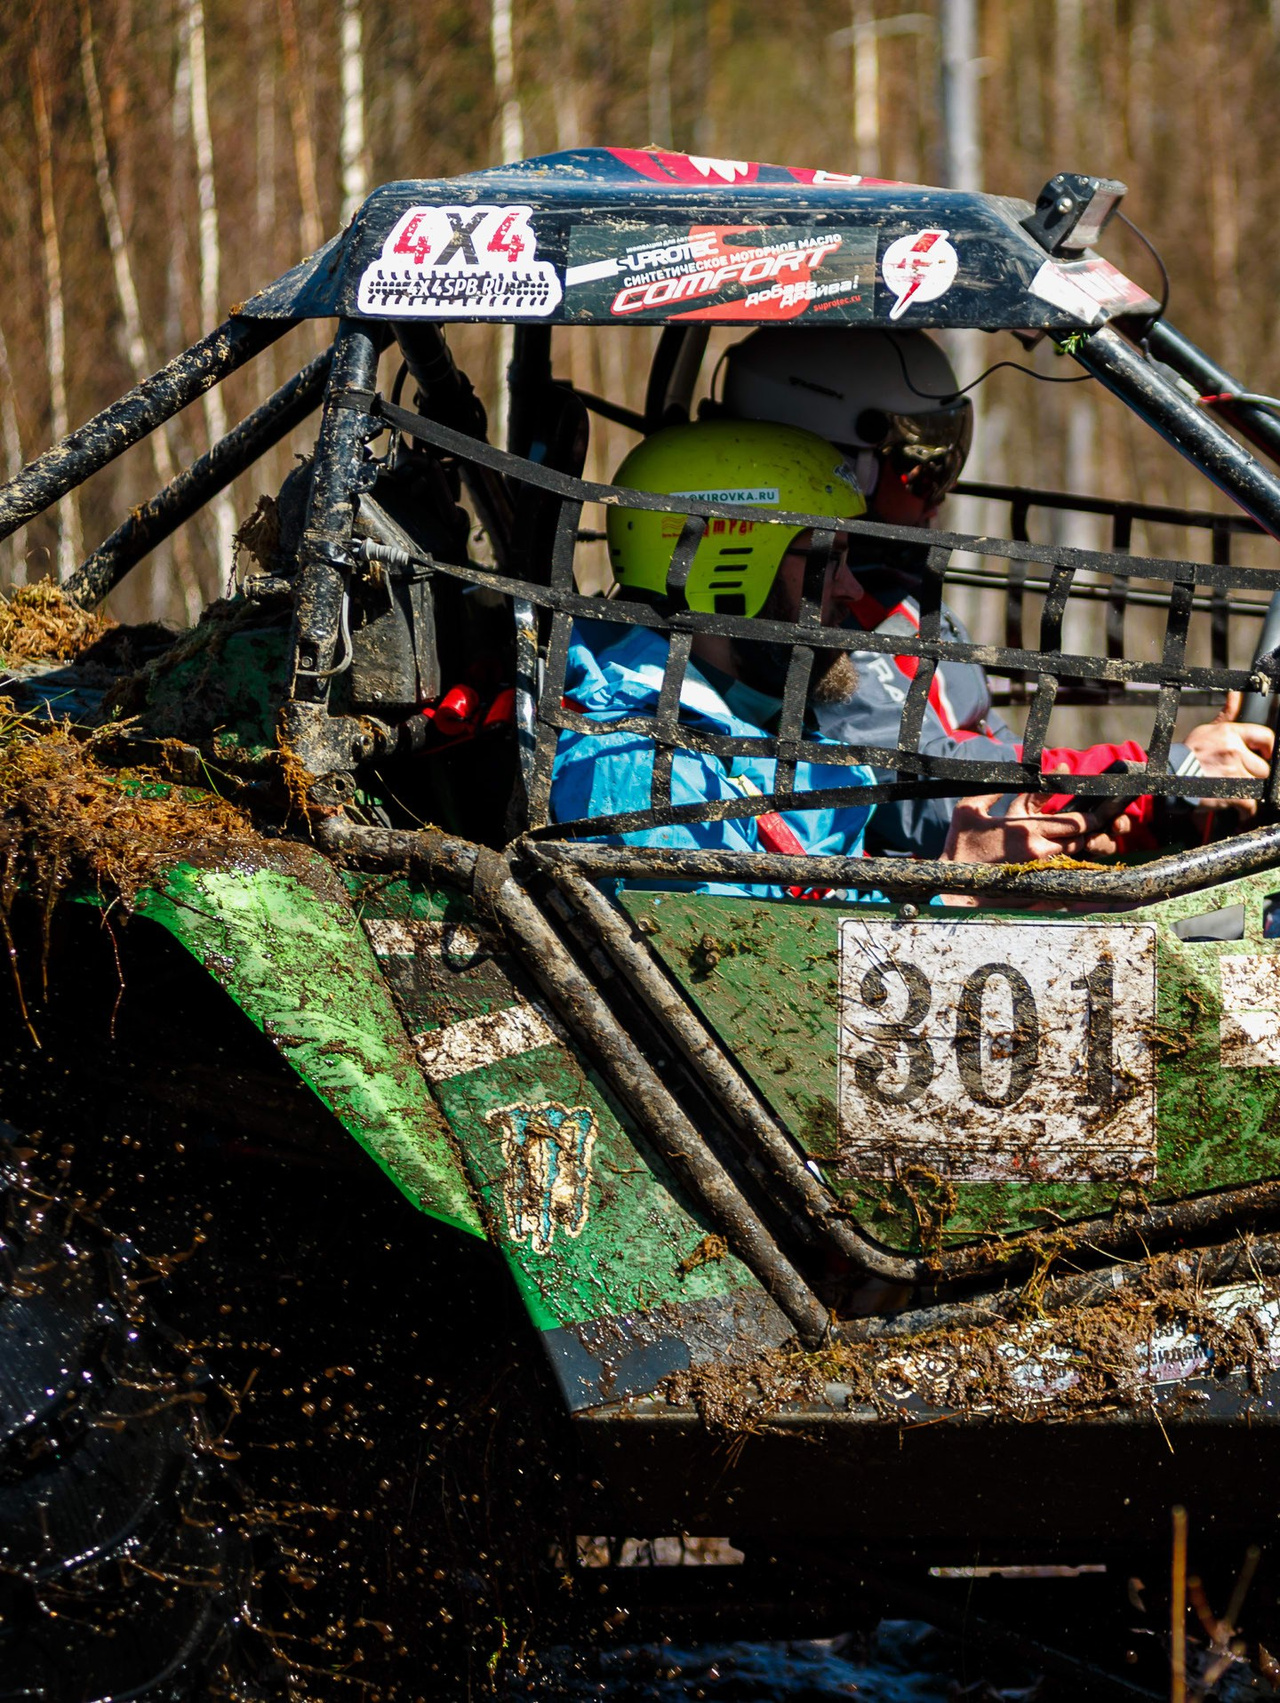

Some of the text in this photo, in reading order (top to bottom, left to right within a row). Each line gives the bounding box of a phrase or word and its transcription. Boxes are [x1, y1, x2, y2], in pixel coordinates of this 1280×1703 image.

[393, 212, 525, 266] 4X4
[623, 233, 843, 288] СИНТЕТИЧЕСКОЕ МОТОРНОЕ МАСЛО
[612, 242, 840, 313] COMFORT
[813, 294, 862, 313] suprotec.ru
[854, 960, 1124, 1109] 301
